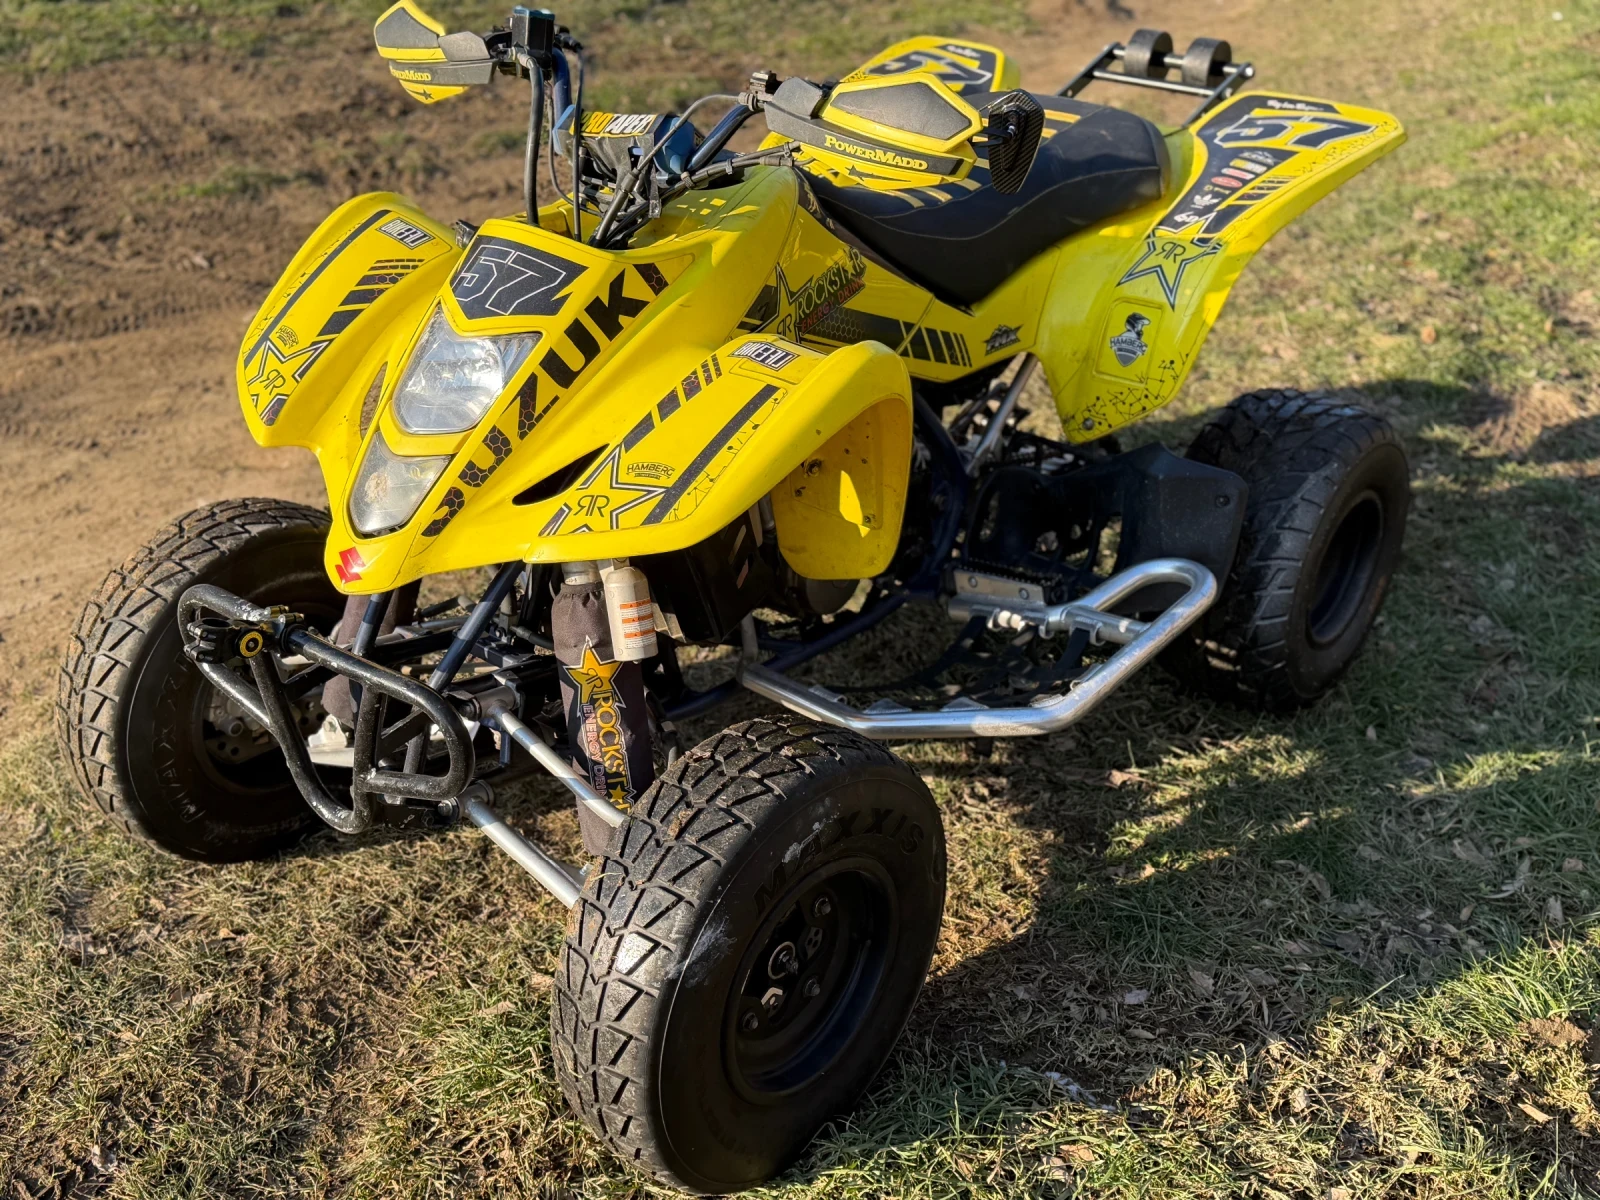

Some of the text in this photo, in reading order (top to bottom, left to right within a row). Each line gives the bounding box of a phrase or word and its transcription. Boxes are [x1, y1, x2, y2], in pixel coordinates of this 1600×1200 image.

[452, 244, 567, 316] 57
[802, 297, 835, 333] ENERGY
[421, 262, 670, 538] SUZUKI
[582, 695, 604, 762] ENERGY
[753, 807, 925, 915] MAXXIS
